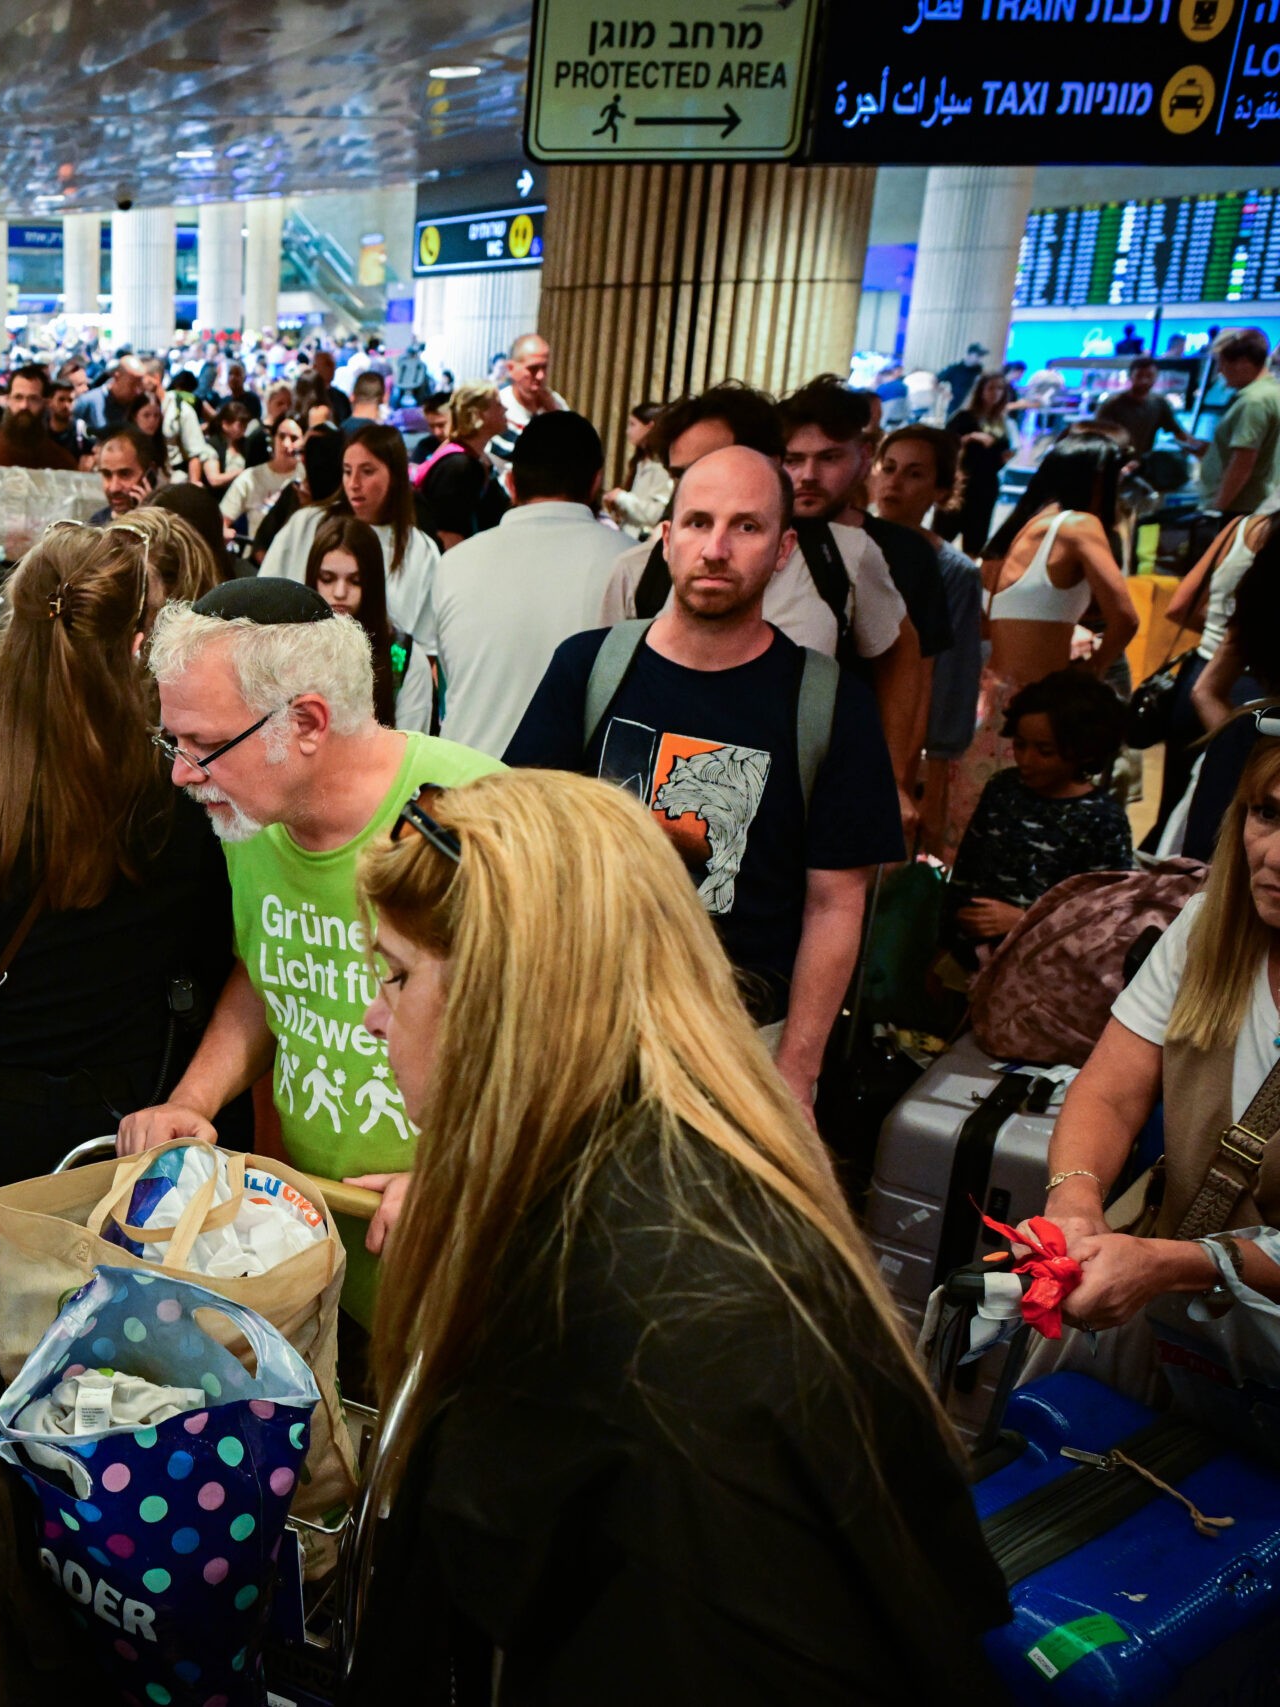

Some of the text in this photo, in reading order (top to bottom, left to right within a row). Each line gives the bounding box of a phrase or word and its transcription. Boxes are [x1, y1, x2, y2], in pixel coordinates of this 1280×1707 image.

[588, 20, 763, 56] מרחב מוגן
[554, 60, 787, 89] PROTECTED AREA
[835, 65, 973, 128] سيارات أجرة
[981, 81, 1050, 116] TAXI
[1056, 81, 1154, 116] מוניות
[261, 894, 378, 953] Grüne
[260, 942, 384, 1008] Licht fü
